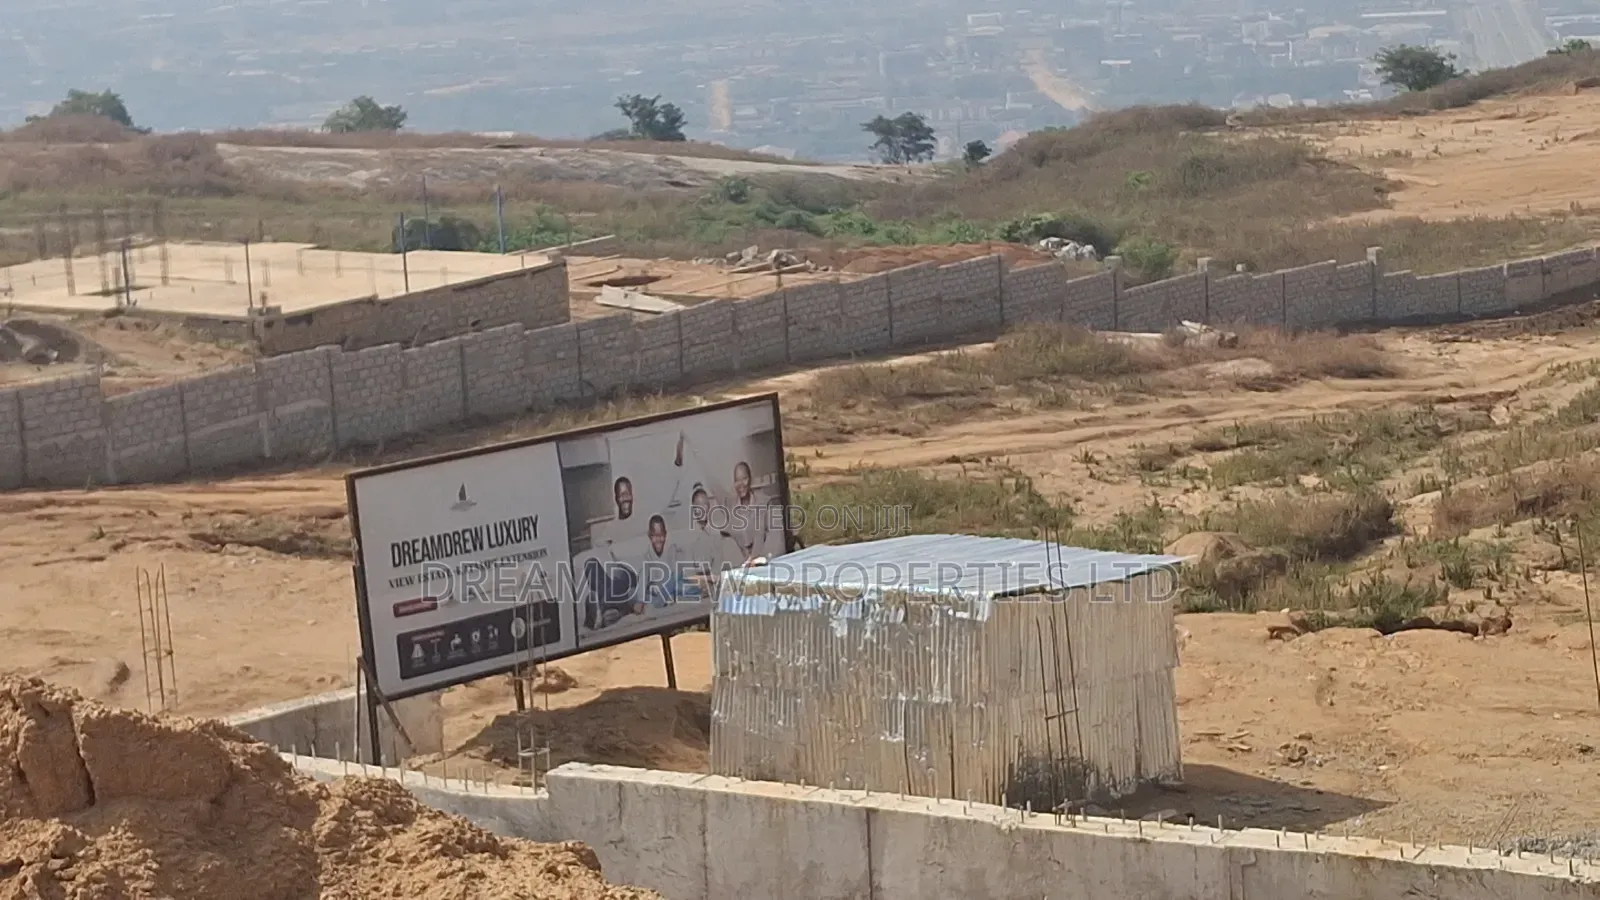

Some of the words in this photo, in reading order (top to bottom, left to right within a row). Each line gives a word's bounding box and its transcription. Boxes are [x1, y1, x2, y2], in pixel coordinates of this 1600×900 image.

[390, 526, 485, 569] DREAMDREW
[486, 514, 540, 550] LUXURY
[388, 573, 415, 590] VIEW
